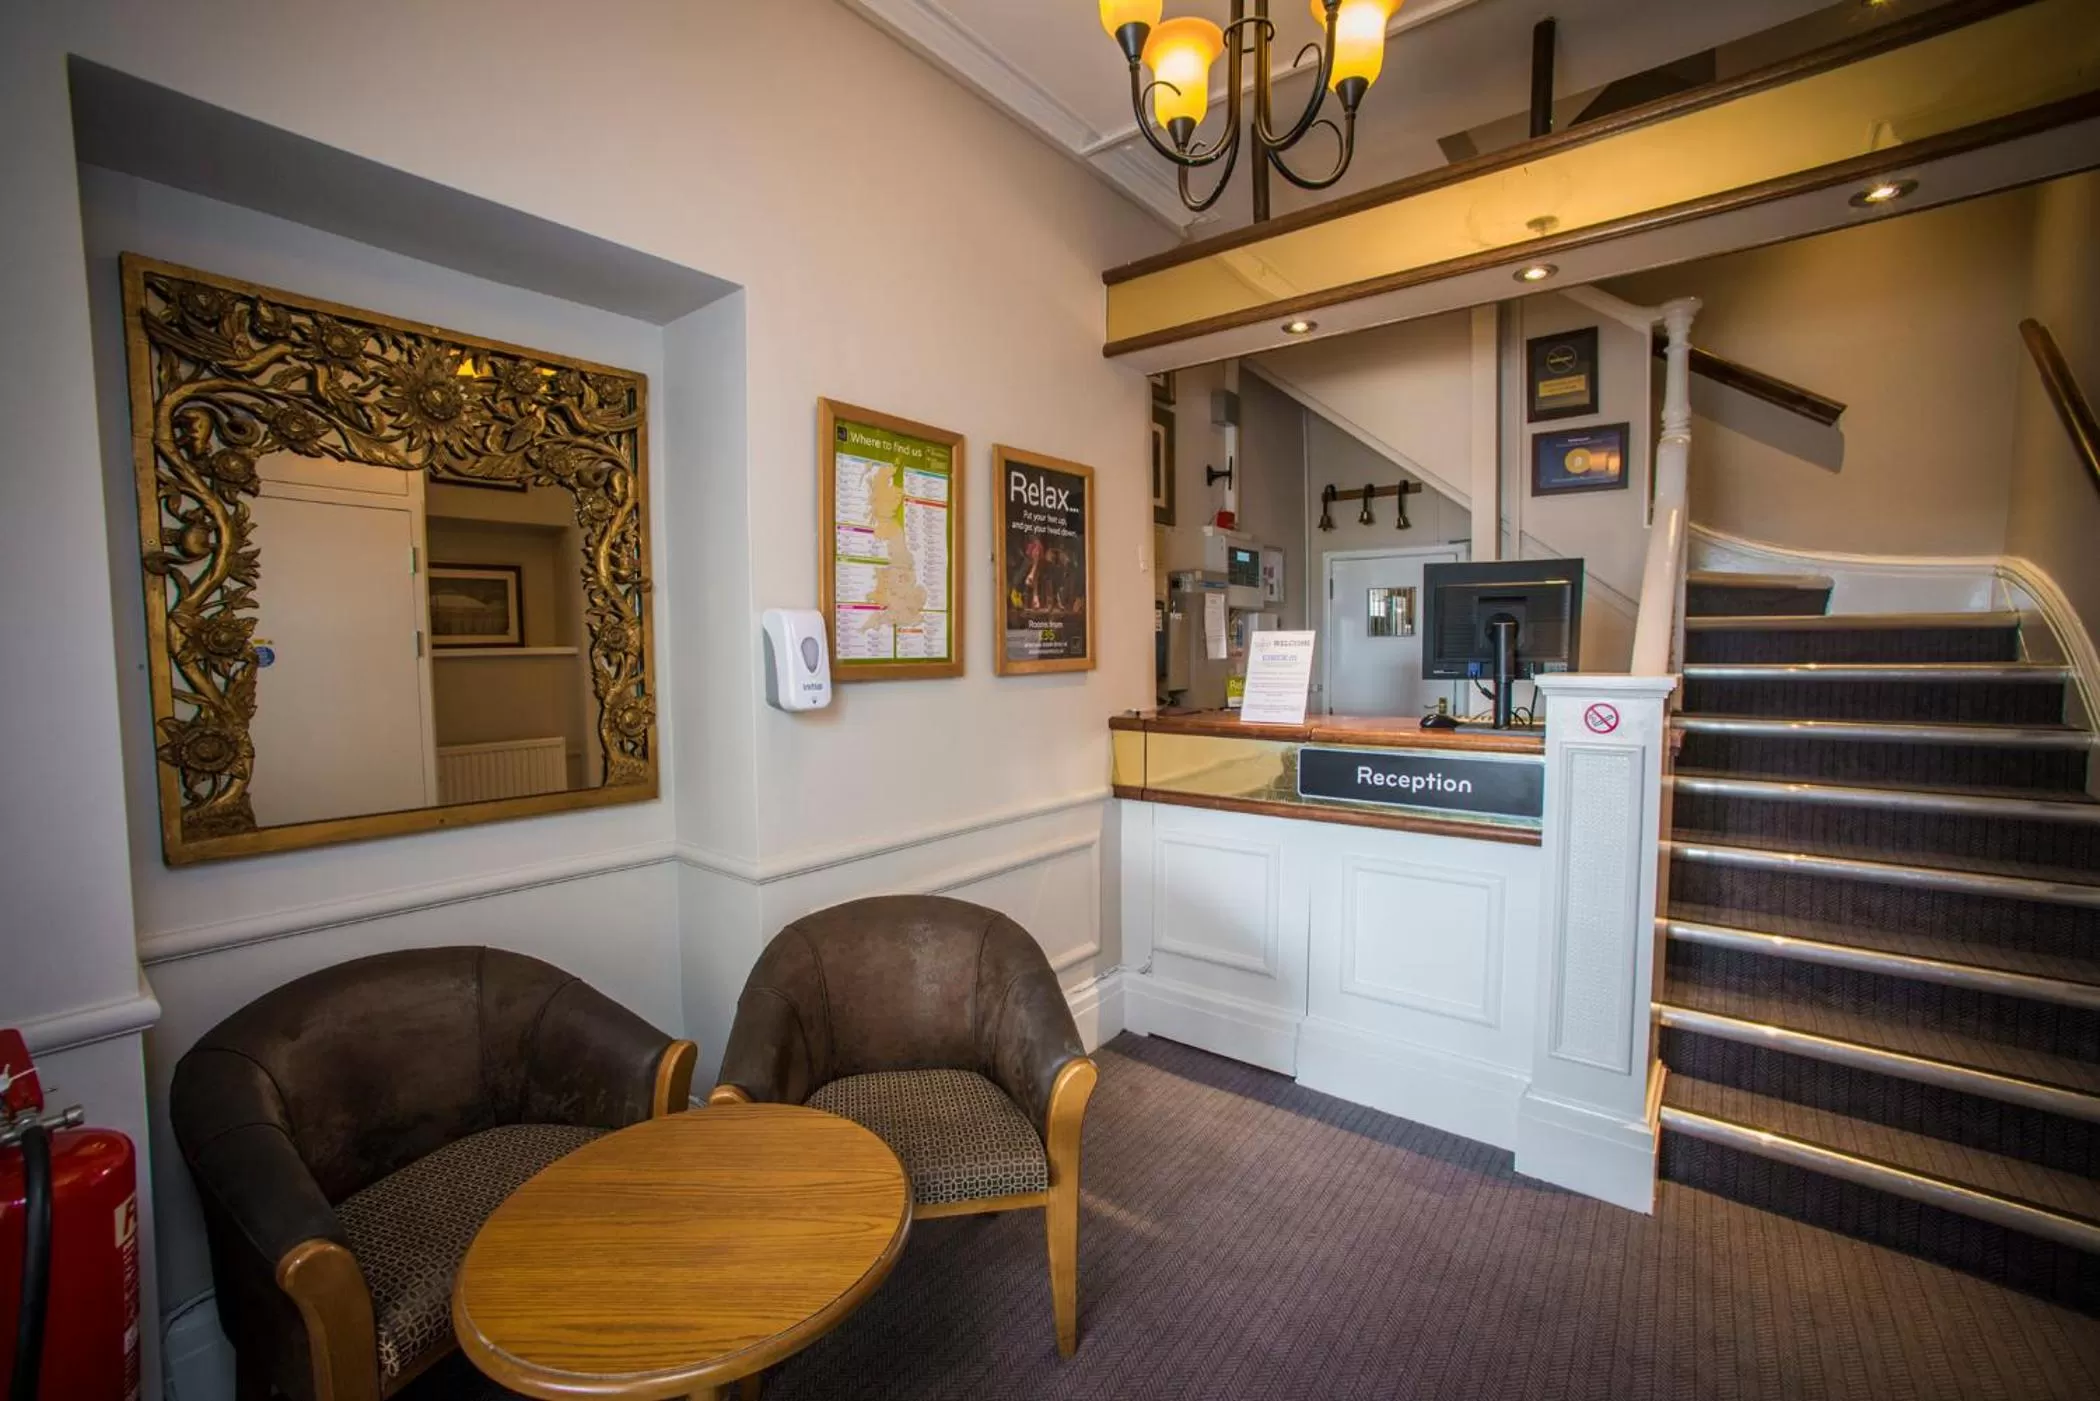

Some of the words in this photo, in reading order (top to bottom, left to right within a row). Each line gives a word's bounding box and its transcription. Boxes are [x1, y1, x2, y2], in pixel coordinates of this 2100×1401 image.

[850, 432, 881, 449] Where
[882, 440, 892, 451] to
[893, 443, 910, 456] find
[911, 448, 923, 457] us
[1033, 513, 1046, 522] your
[1357, 765, 1473, 793] Reception
